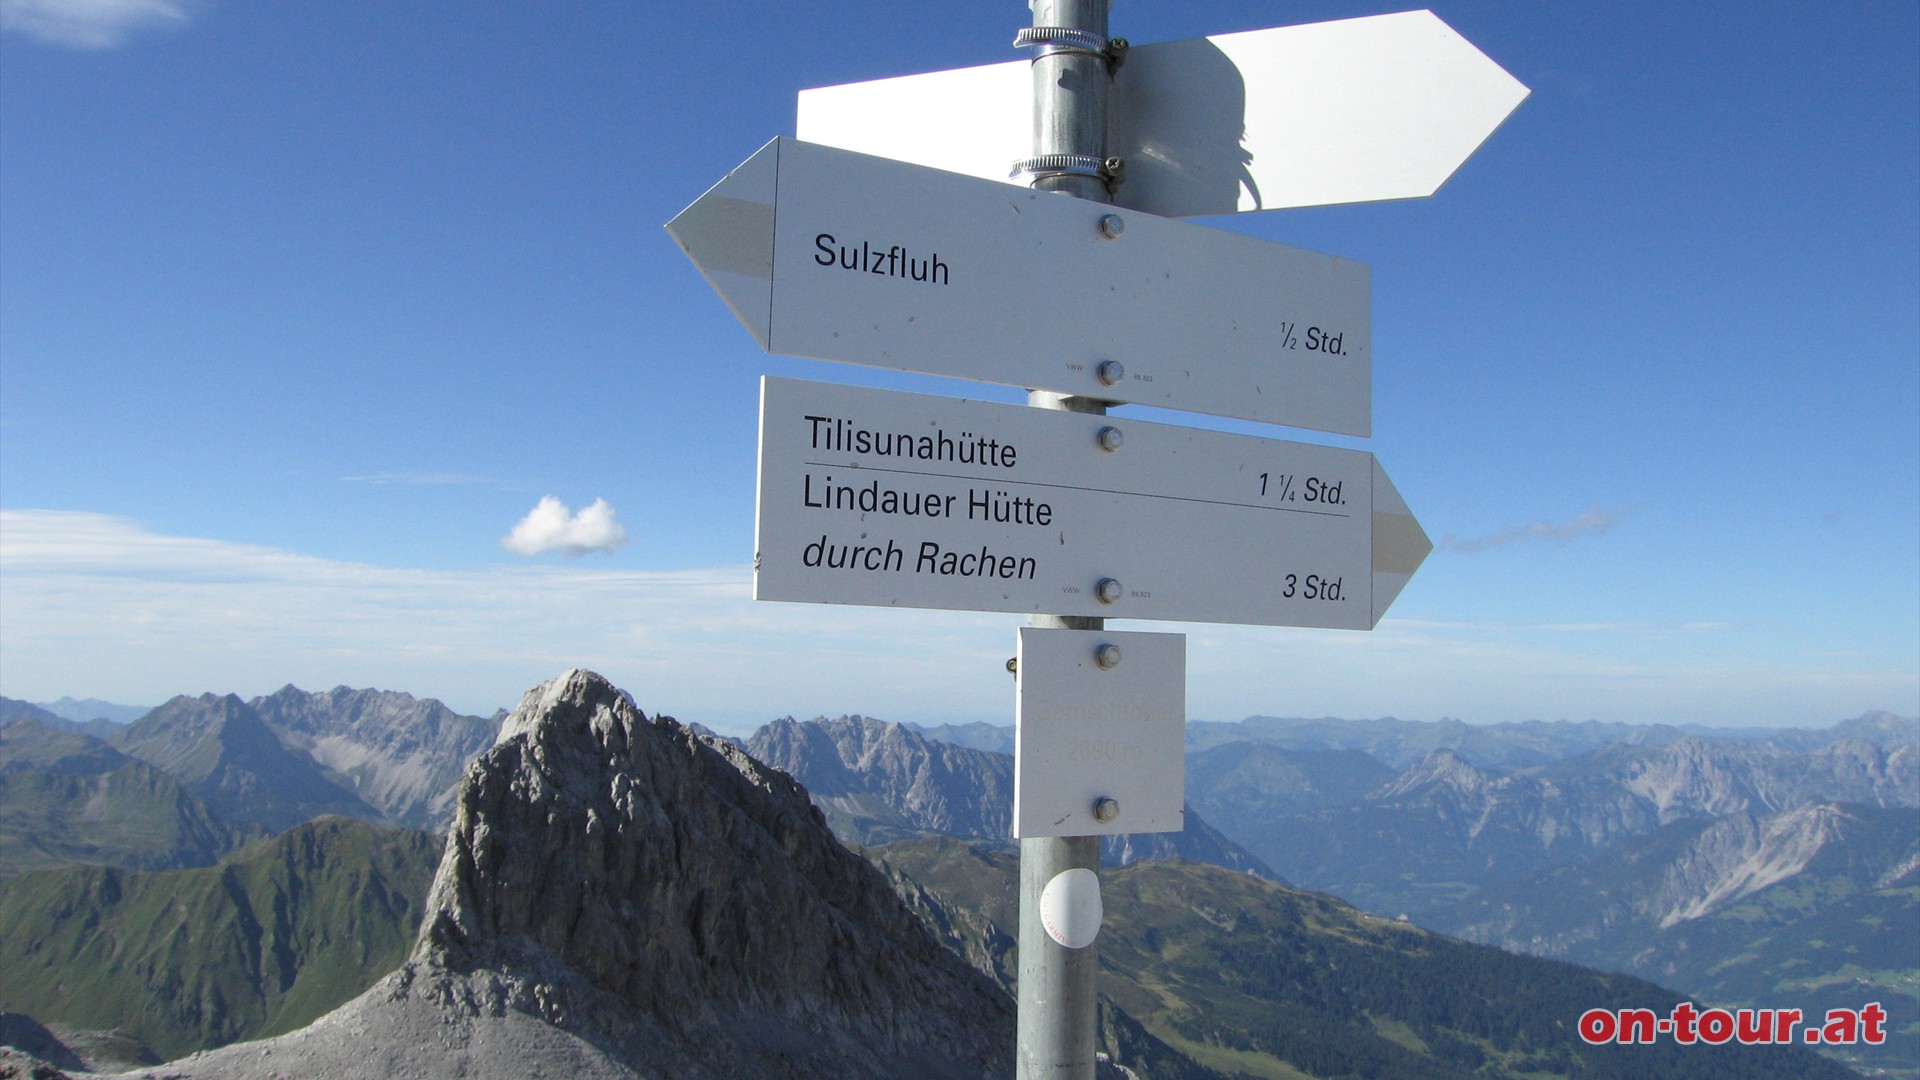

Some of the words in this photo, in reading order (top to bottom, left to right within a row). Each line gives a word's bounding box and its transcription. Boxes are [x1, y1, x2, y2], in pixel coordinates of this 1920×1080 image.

[814, 233, 949, 286] Sulzfluh
[1305, 326, 1347, 356] Std.
[804, 415, 1017, 468] Tilisunahütte
[804, 474, 956, 518] Lindauer
[968, 488, 1052, 526] Hütte
[1259, 472, 1268, 496] 1
[1304, 477, 1346, 505] Std.
[802, 534, 904, 572] durch
[915, 541, 1037, 580] Rachen
[1282, 573, 1297, 599] 3
[1304, 574, 1346, 601] Std.
